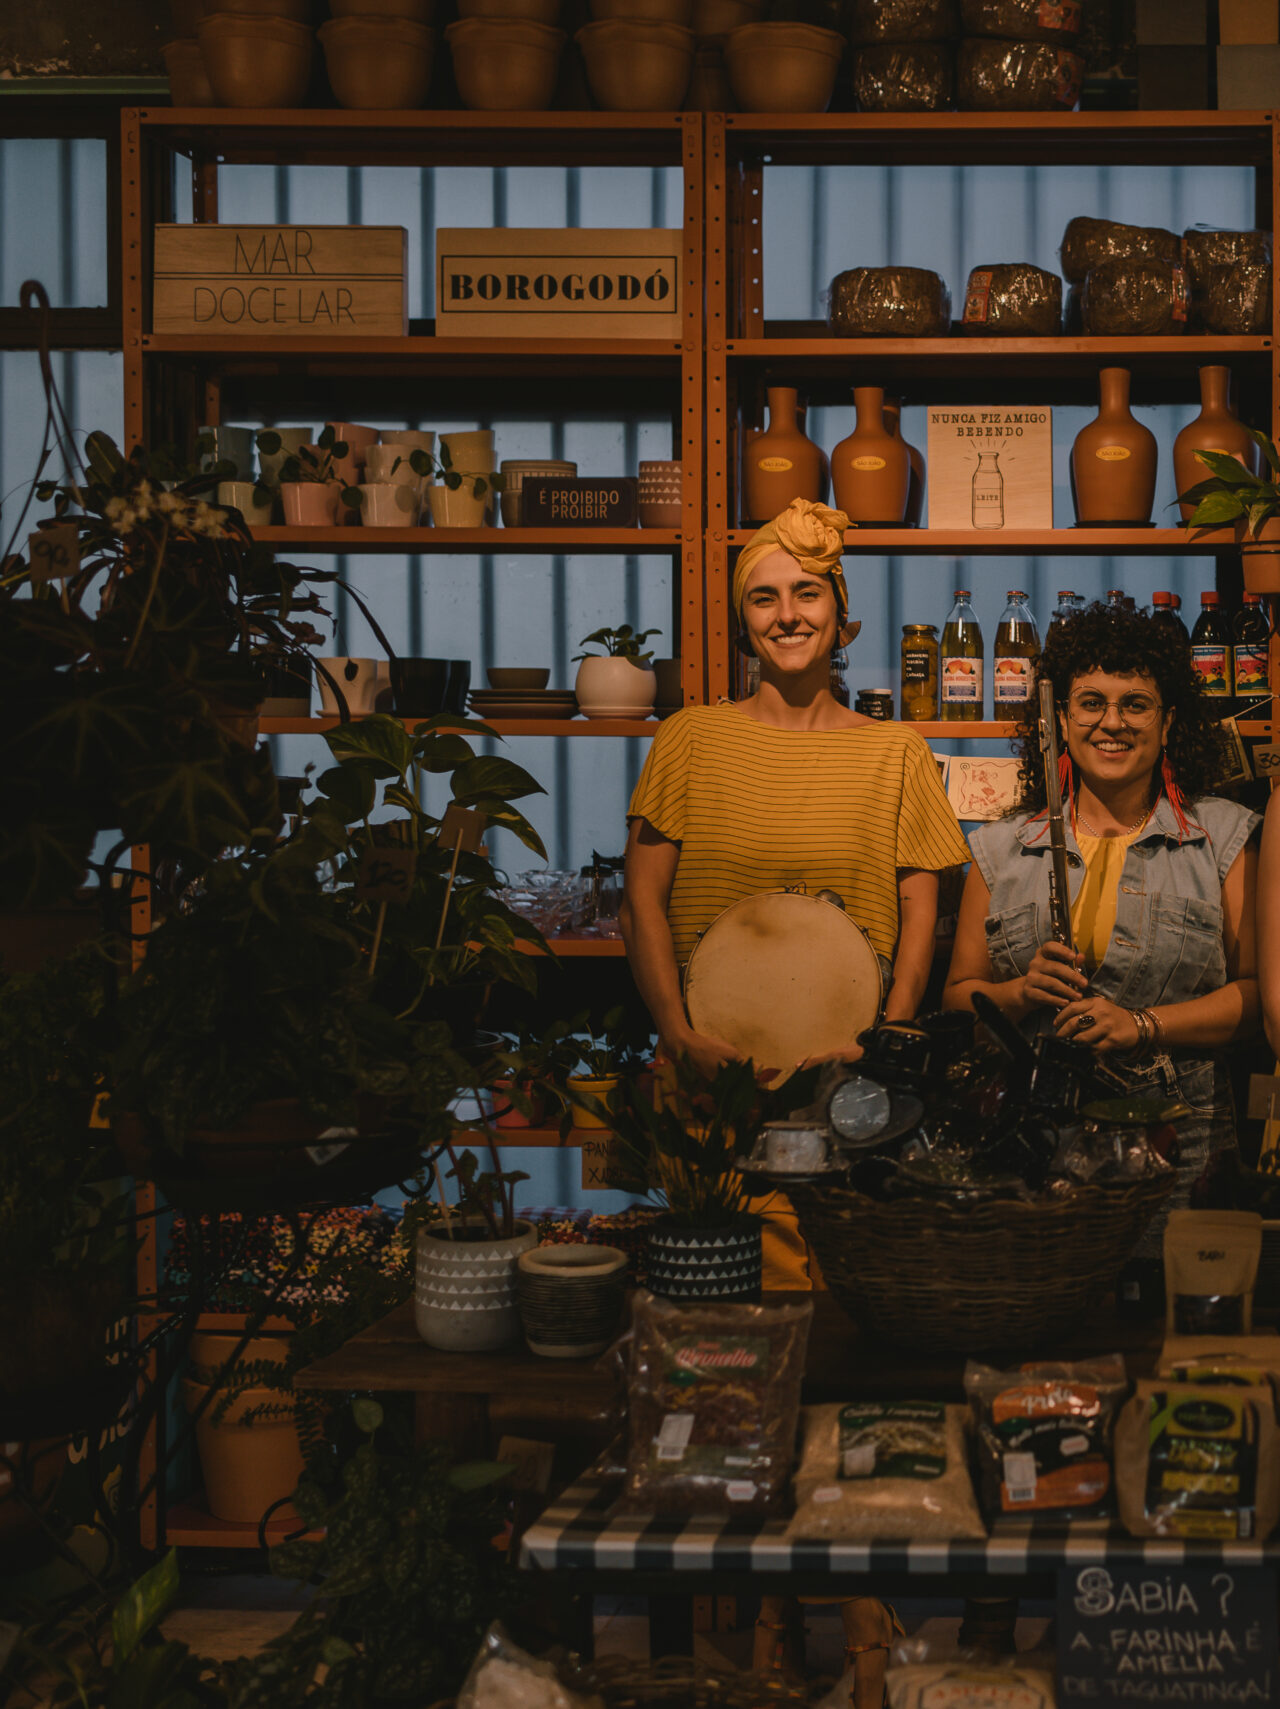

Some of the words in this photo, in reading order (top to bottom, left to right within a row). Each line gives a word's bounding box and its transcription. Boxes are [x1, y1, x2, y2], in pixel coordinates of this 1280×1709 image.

[234, 230, 316, 275] MAR
[450, 268, 669, 301] BOROGODÓ
[931, 412, 977, 425] NUNCA
[982, 412, 1001, 425] FIZ
[1004, 411, 1048, 424] AMIGO
[956, 426, 1024, 438] BEBENDO
[539, 488, 547, 506] É
[551, 490, 620, 506] PROIBIDO
[976, 493, 1000, 502] LEITE
[551, 504, 608, 520] PROIBIR
[1211, 1573, 1235, 1617] ?
[1069, 1630, 1092, 1651] A
[1245, 1620, 1263, 1651] É
[1063, 1675, 1098, 1697] DE
